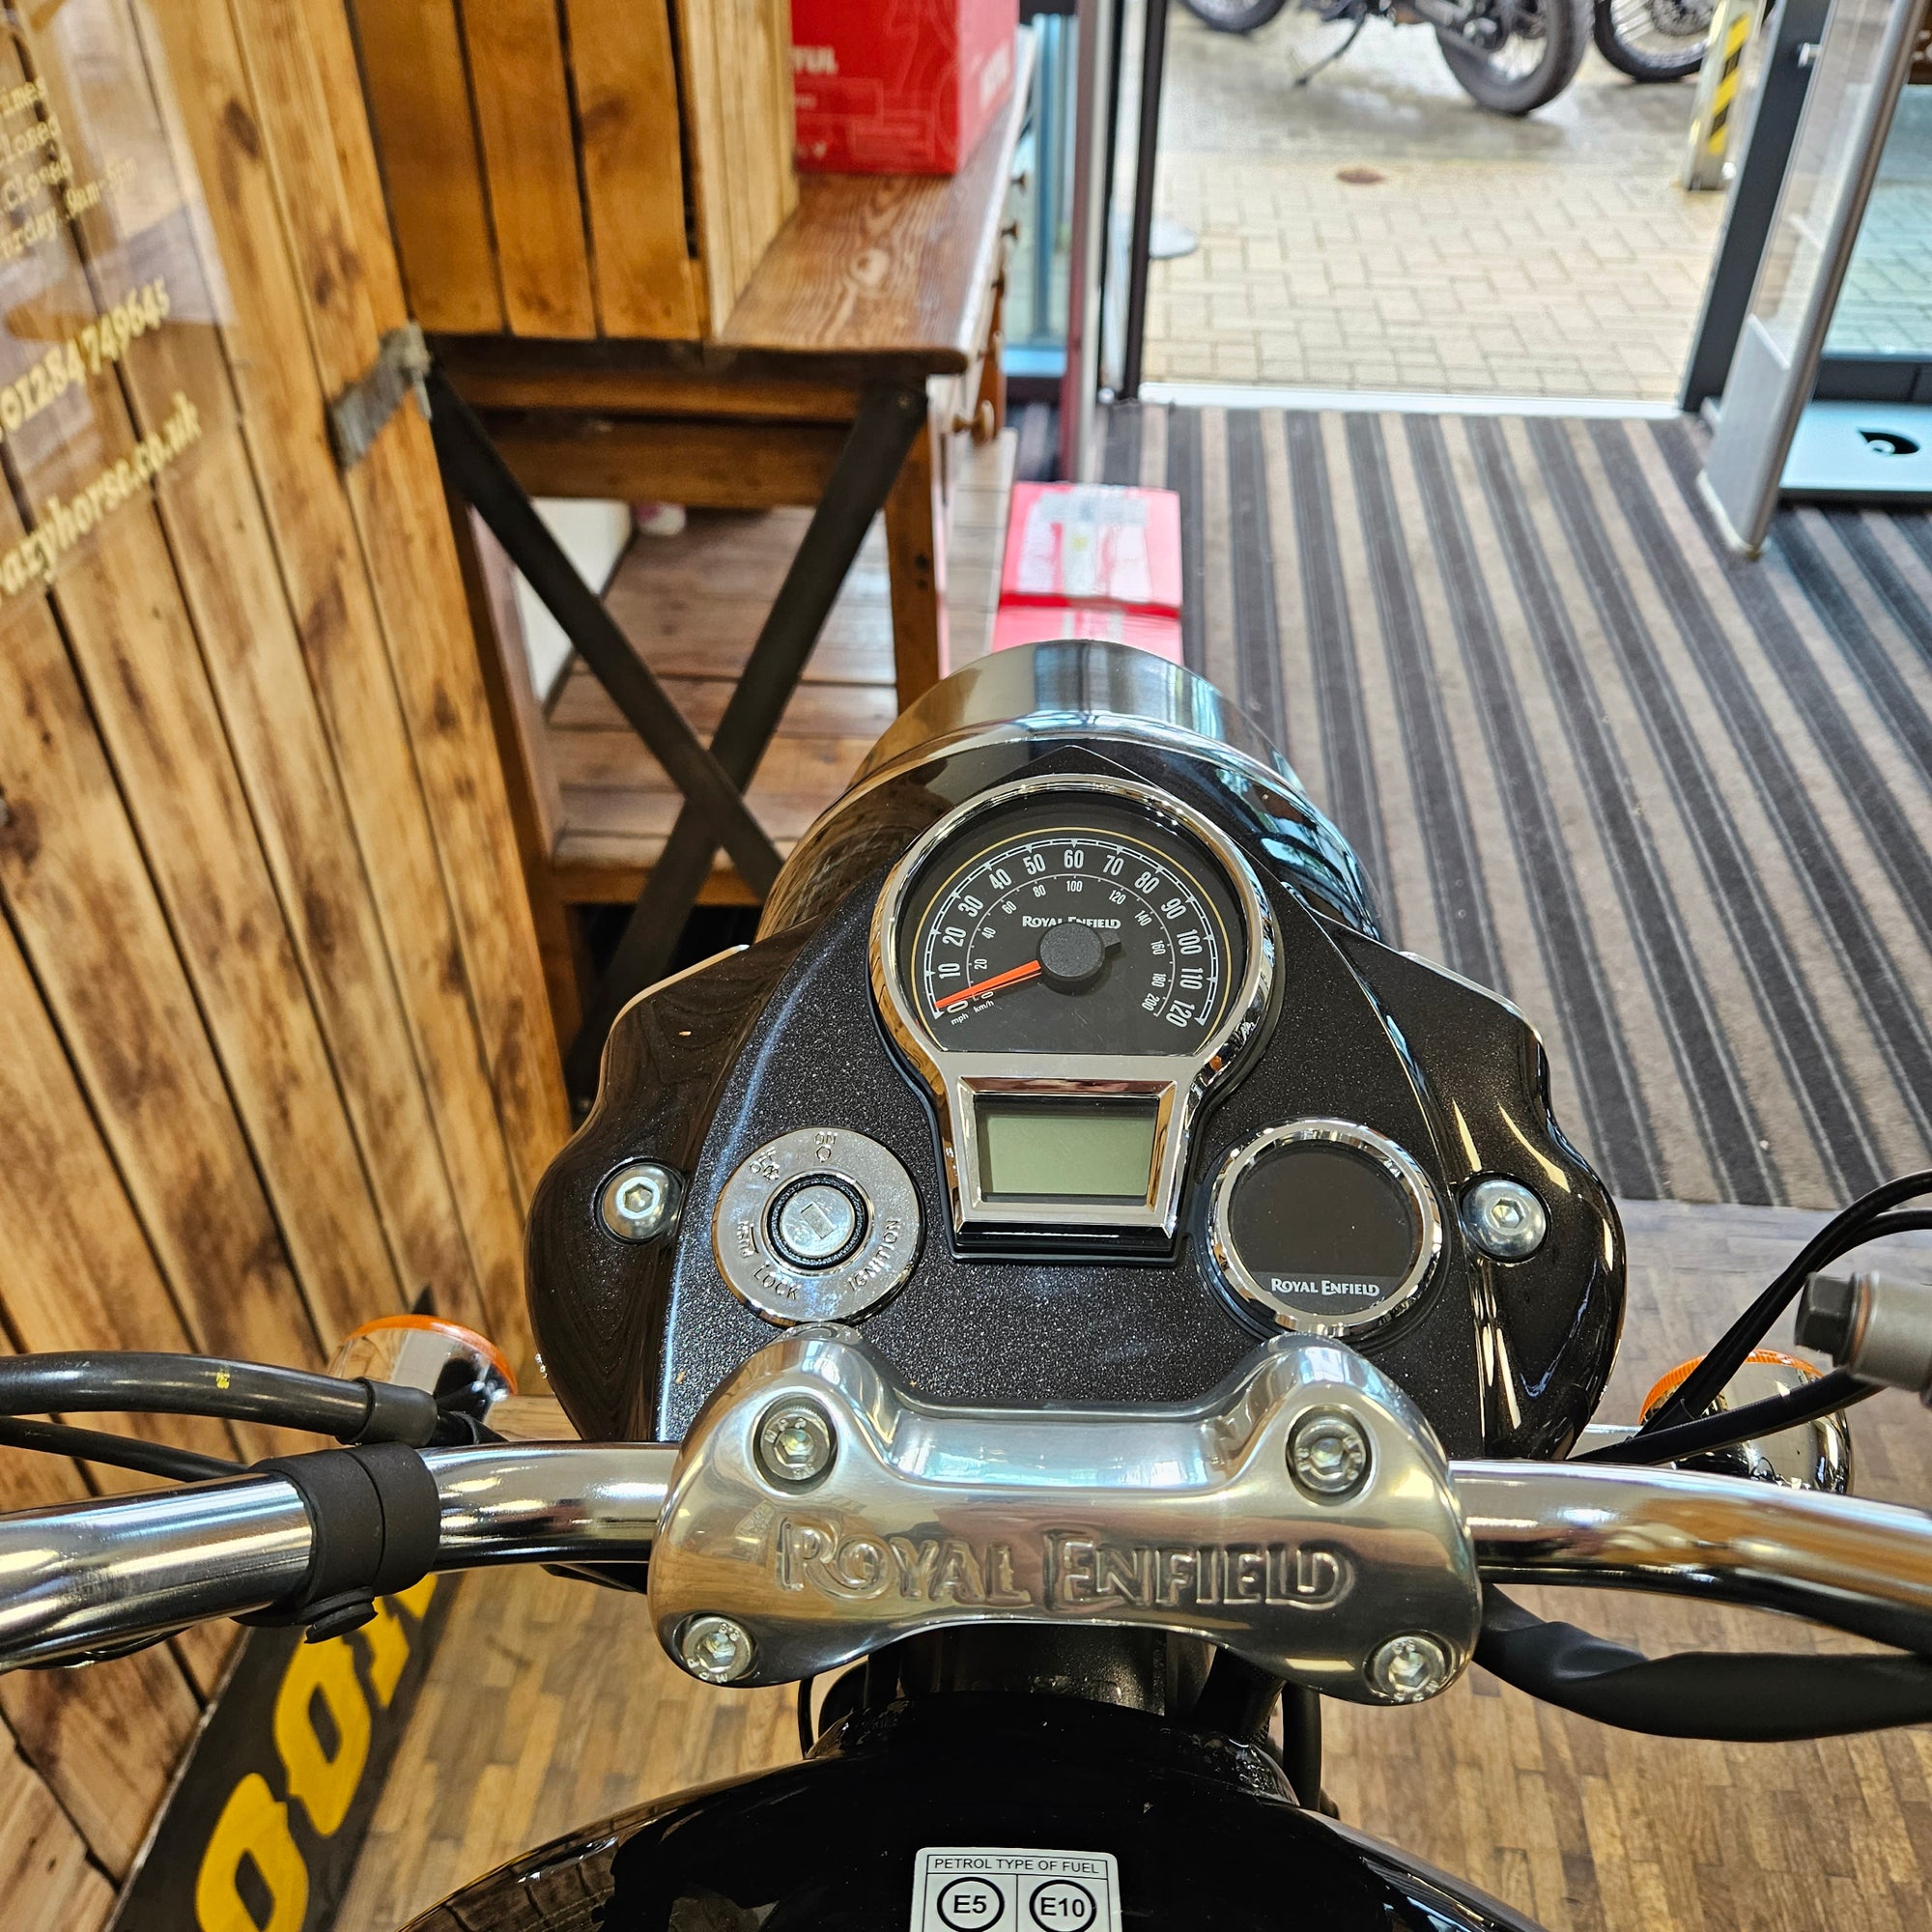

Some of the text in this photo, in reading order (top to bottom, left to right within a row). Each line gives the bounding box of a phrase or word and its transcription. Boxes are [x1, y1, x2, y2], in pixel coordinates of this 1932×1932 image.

[1023, 854, 1046, 875] 50
[1064, 850, 1084, 868] 60
[1102, 855, 1124, 875] 70
[989, 868, 1011, 890] 40
[1066, 880, 1083, 892] 100
[1134, 871, 1159, 894] 80
[1033, 884, 1046, 897] 80
[1108, 890, 1126, 905] 120
[957, 895, 983, 918] 30
[1002, 900, 1017, 914] 60
[1160, 898, 1186, 920] 90
[1134, 910, 1152, 926] 140
[942, 926, 966, 947] 20
[981, 926, 996, 939] 40
[1177, 929, 1203, 954] 100
[1151, 940, 1166, 955] 160
[938, 963, 961, 979] 10
[974, 958, 987, 970] 20
[1151, 973, 1166, 987] 180
[1179, 967, 1204, 989] 110
[947, 1000, 968, 1013] 0
[973, 1000, 994, 1013] km/h
[1142, 993, 1160, 1010] 200
[951, 1013, 969, 1026] mph
[1166, 1000, 1195, 1028] 120
[814, 1131, 838, 1145] ON
[848, 1218, 900, 1292] IGNITION
[753, 1261, 802, 1300] LOCK
[1271, 1278, 1380, 1296] ROYAL ENFIELD
[777, 1515, 1357, 1611] ROYAL ENFIELD
[934, 1858, 1099, 1874] PETROL TYPE OF FUEL
[953, 1894, 987, 1915] E5
[1040, 1896, 1086, 1918] E10
